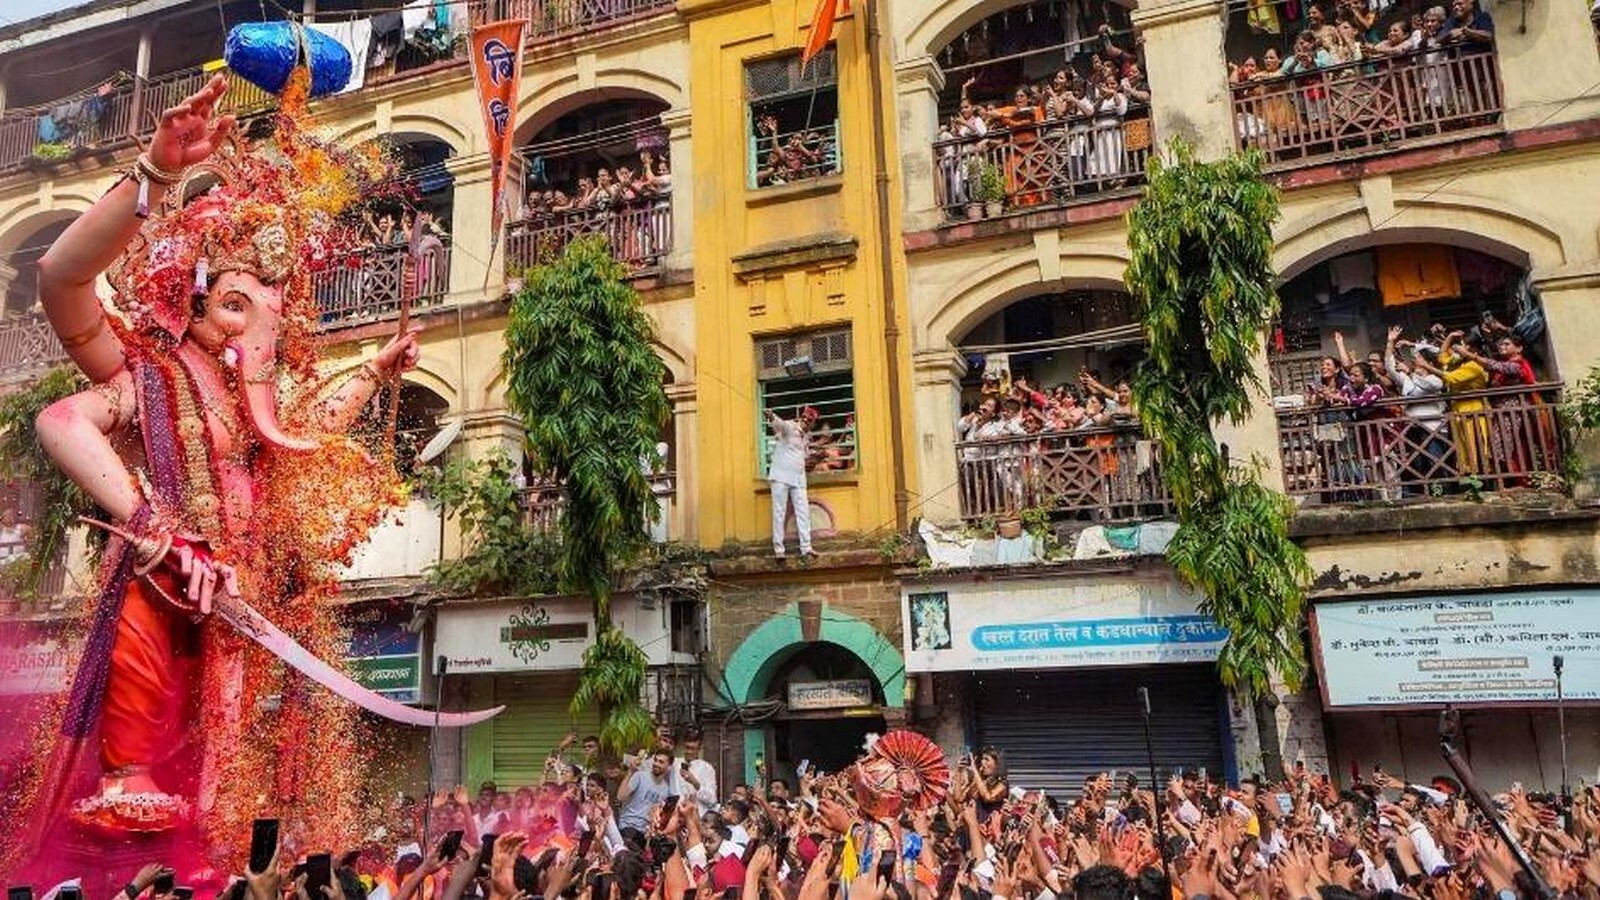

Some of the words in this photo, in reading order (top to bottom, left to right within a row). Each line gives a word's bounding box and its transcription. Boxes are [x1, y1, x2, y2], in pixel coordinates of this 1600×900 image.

[1019, 629, 1049, 644] दरात
[1054, 624, 1077, 642] तेल
[1082, 626, 1092, 640] व
